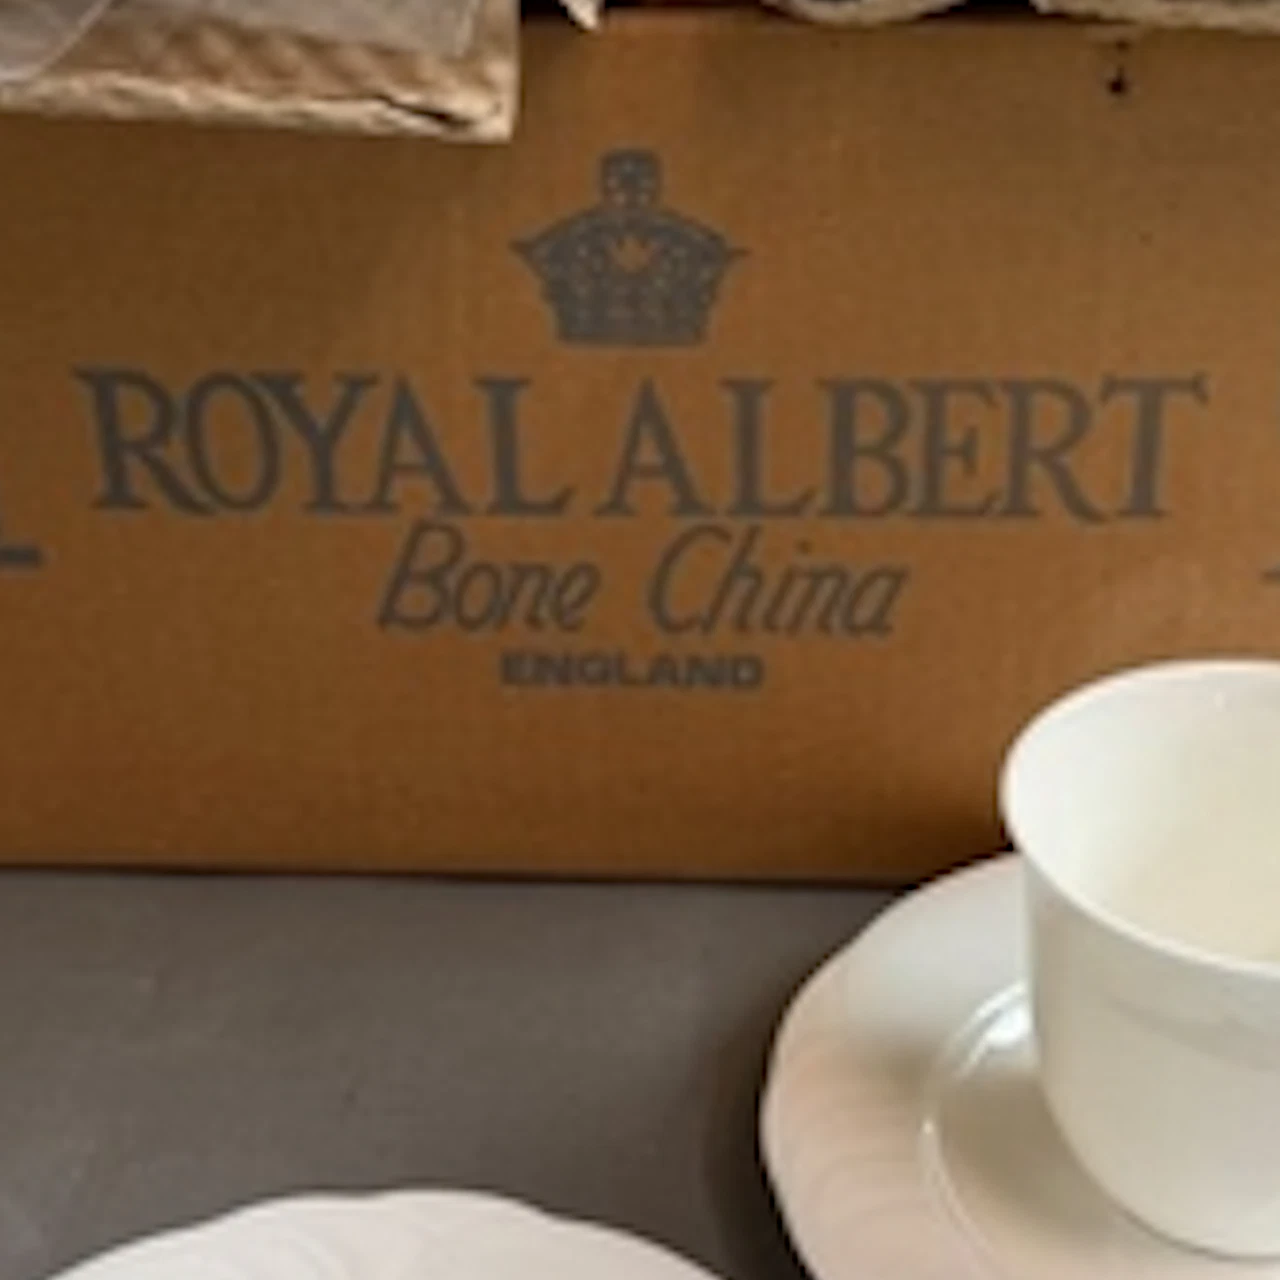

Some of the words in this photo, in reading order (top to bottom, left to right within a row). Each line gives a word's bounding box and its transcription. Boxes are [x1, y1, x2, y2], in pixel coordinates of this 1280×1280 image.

[72, 365, 576, 517] ROYAL
[594, 372, 1210, 523] ALBERT
[378, 520, 602, 634] Bone
[646, 523, 906, 637] China
[499, 651, 765, 689] ENGLAND
